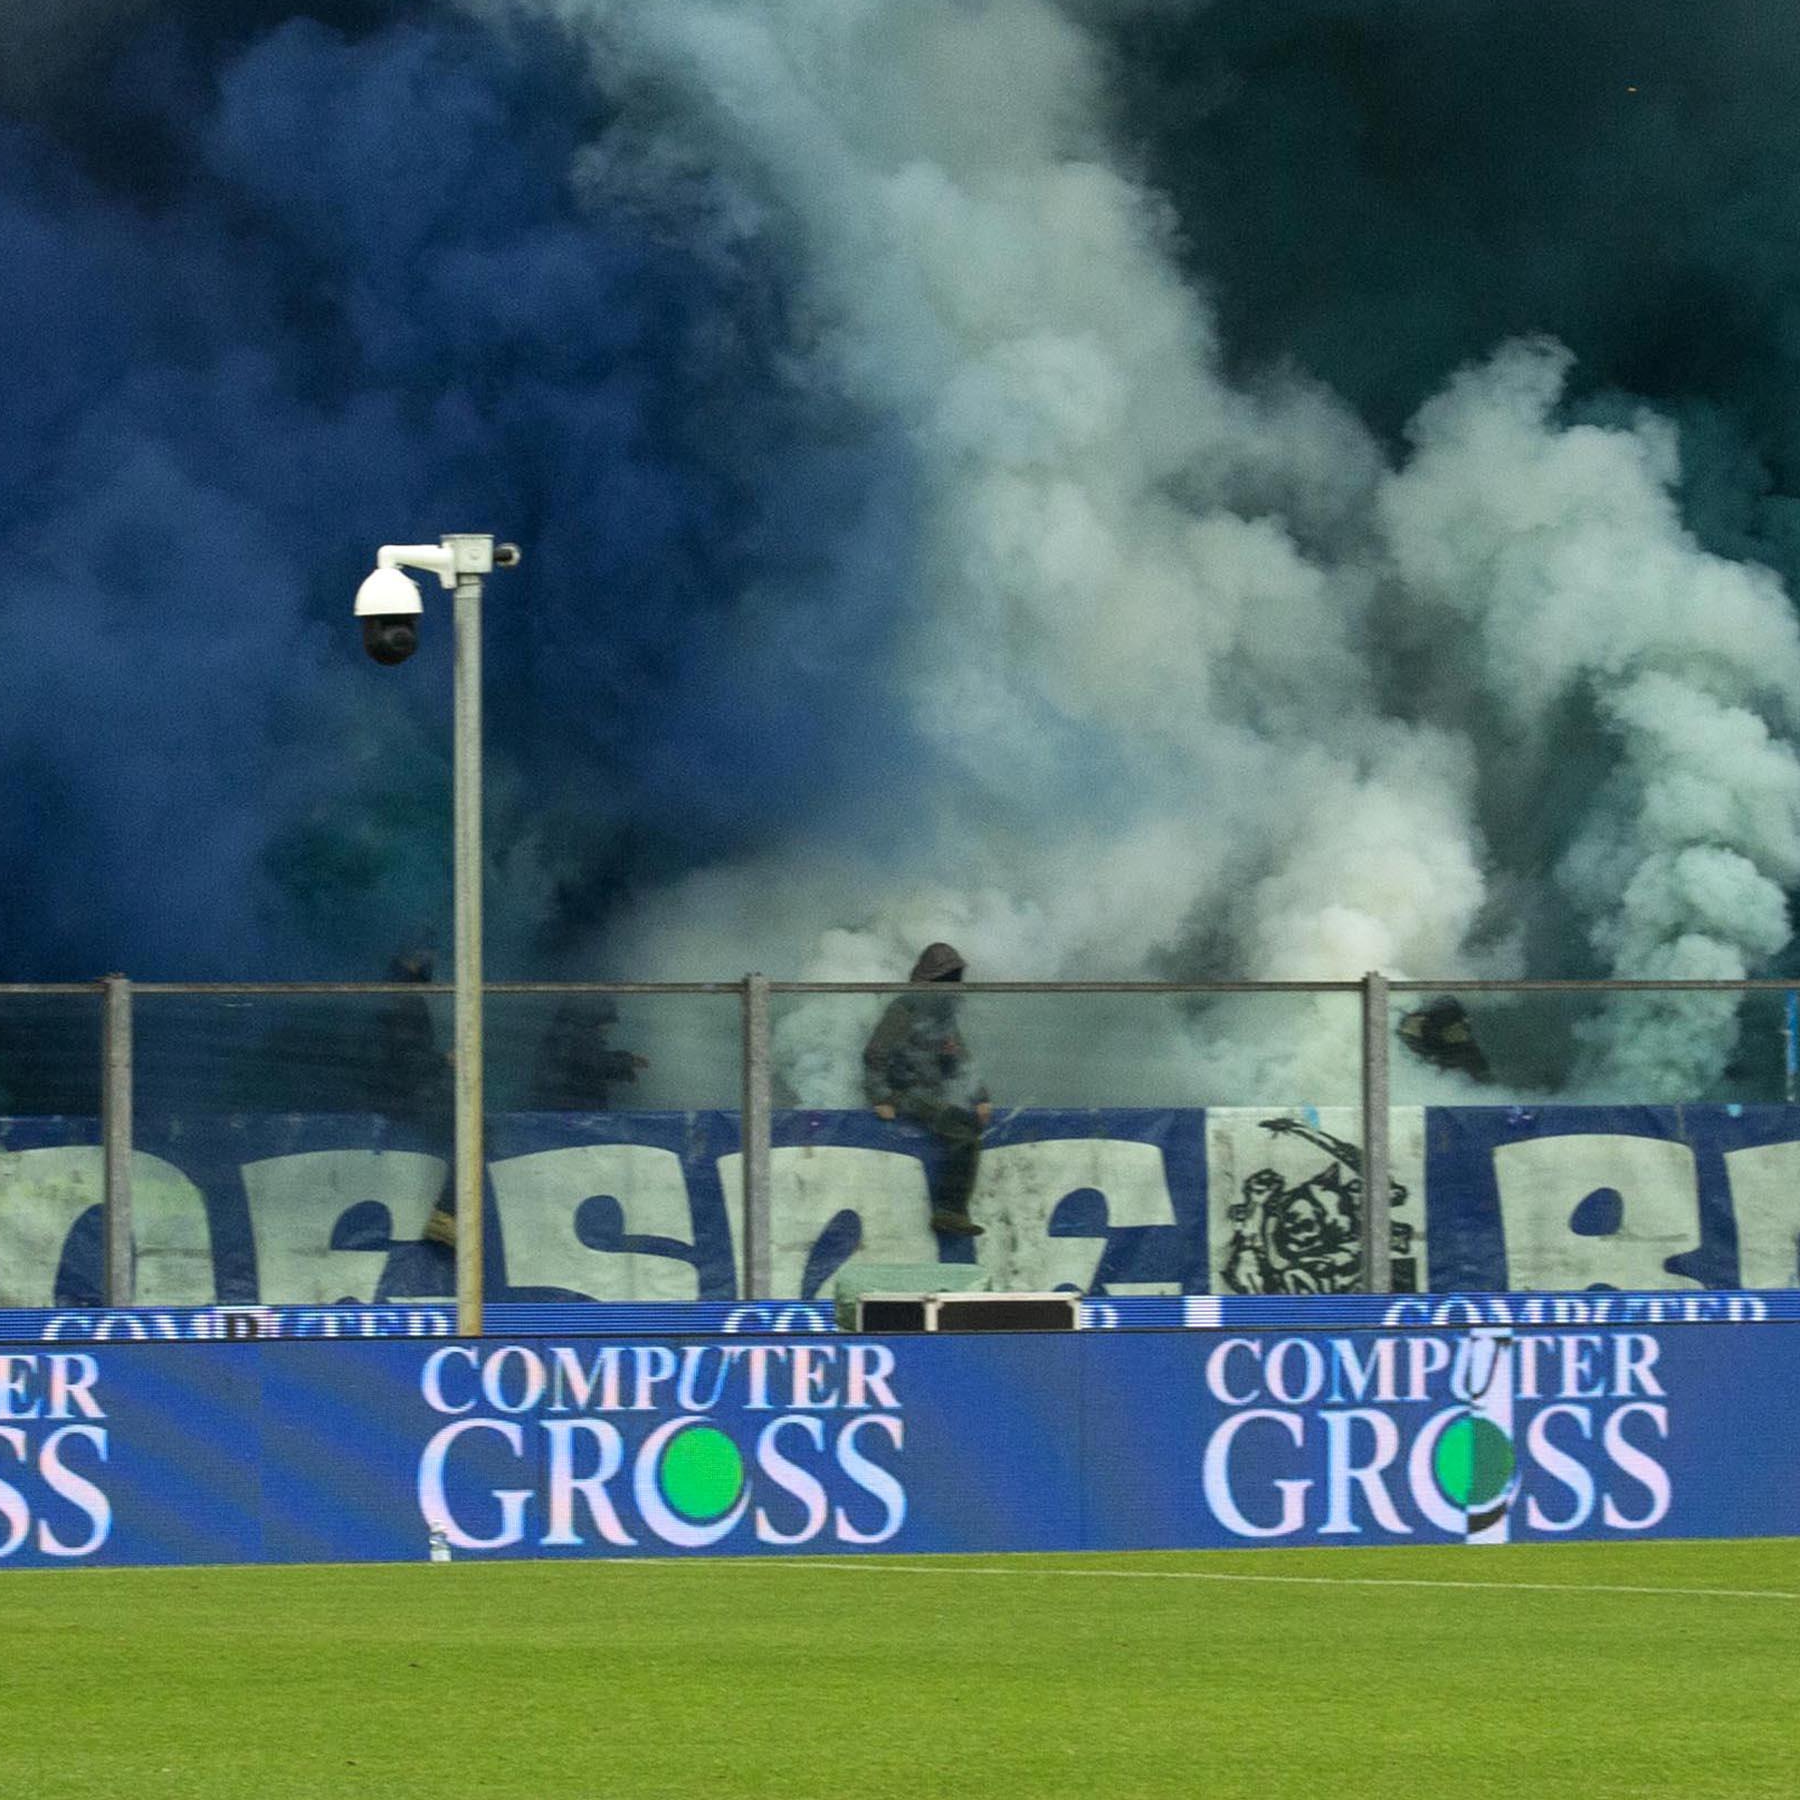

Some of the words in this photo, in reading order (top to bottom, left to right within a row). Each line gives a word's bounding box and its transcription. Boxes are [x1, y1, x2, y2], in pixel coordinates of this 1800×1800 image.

[420, 1344, 903, 1415] COMPUTER
[1205, 1332, 1667, 1404] COMPUTER
[417, 1413, 908, 1549] GROSS
